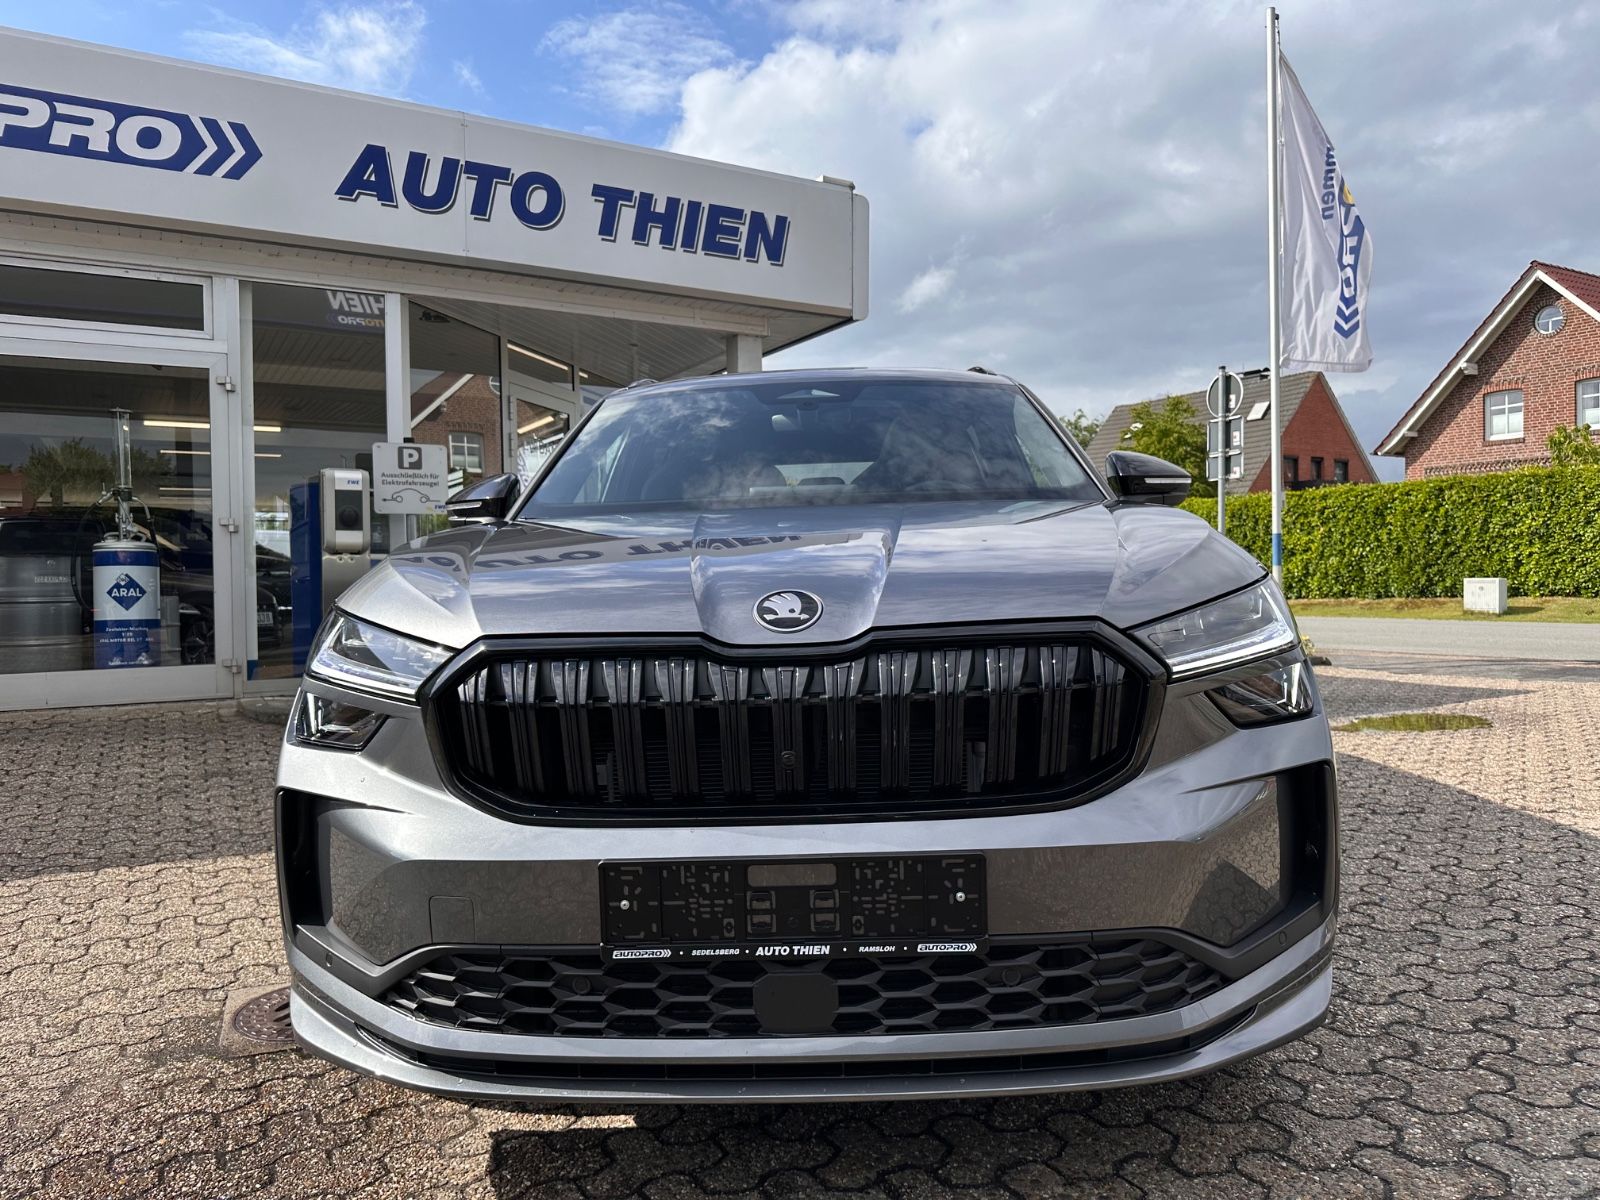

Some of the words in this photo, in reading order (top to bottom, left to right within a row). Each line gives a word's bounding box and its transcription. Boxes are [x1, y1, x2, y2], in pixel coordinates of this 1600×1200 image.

[0, 93, 182, 161] PRO
[334, 143, 566, 231] AUTO
[591, 183, 791, 266] THIEN
[403, 448, 419, 468] P
[111, 588, 142, 597] ARAL
[691, 948, 740, 956] SEDELSBERG
[755, 946, 790, 956] AUTO
[792, 945, 831, 956] THIEN
[858, 945, 896, 953] RAMSLOH
